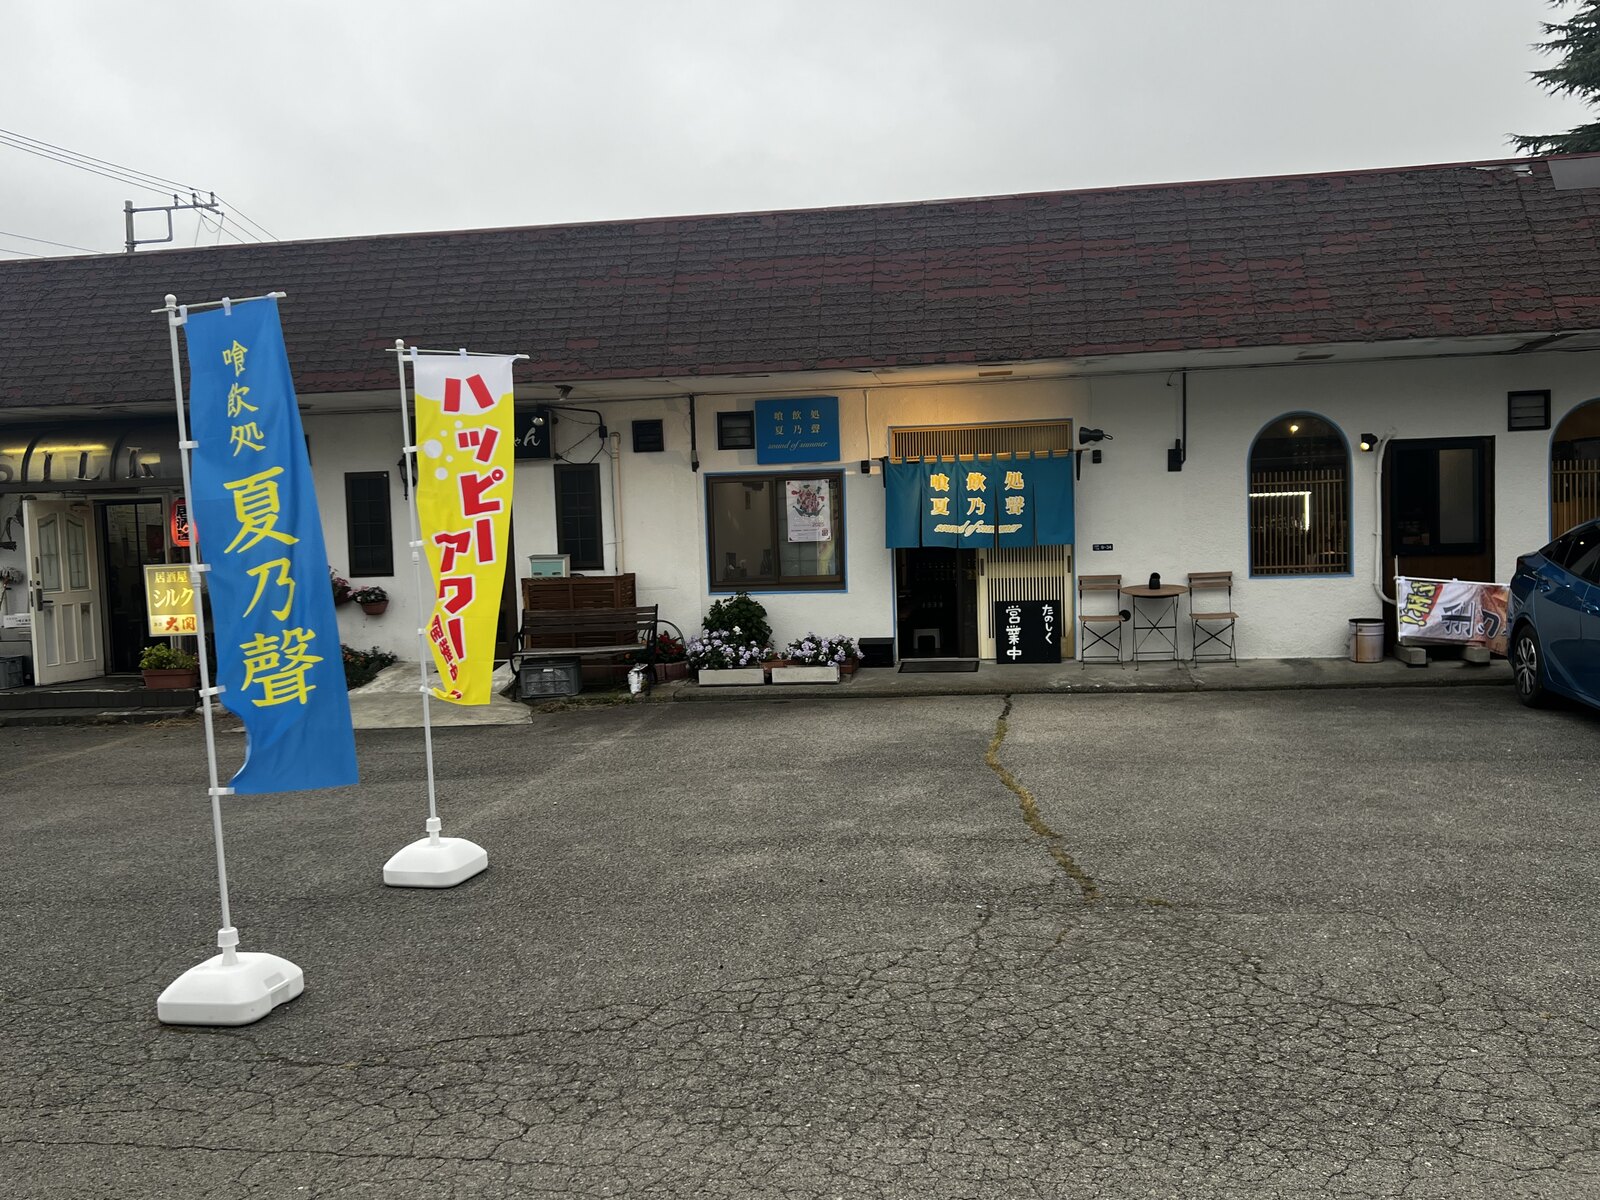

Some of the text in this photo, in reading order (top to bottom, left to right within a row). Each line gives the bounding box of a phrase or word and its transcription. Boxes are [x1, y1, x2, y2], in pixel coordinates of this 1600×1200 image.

[223, 340, 266, 457] 喰飲処
[768, 440, 791, 449] sound
[789, 439, 801, 451] of
[443, 374, 505, 563] ハッピー
[930, 496, 1025, 516] 夏乃聲
[934, 520, 971, 534] sound
[964, 519, 985, 538] of
[154, 571, 188, 583] 居酒屋
[223, 466, 323, 708] 夏乃聲
[434, 530, 474, 661] アワー
[153, 587, 195, 608] シルク
[1005, 605, 1022, 660] 営業中
[1042, 604, 1054, 644] たのしく
